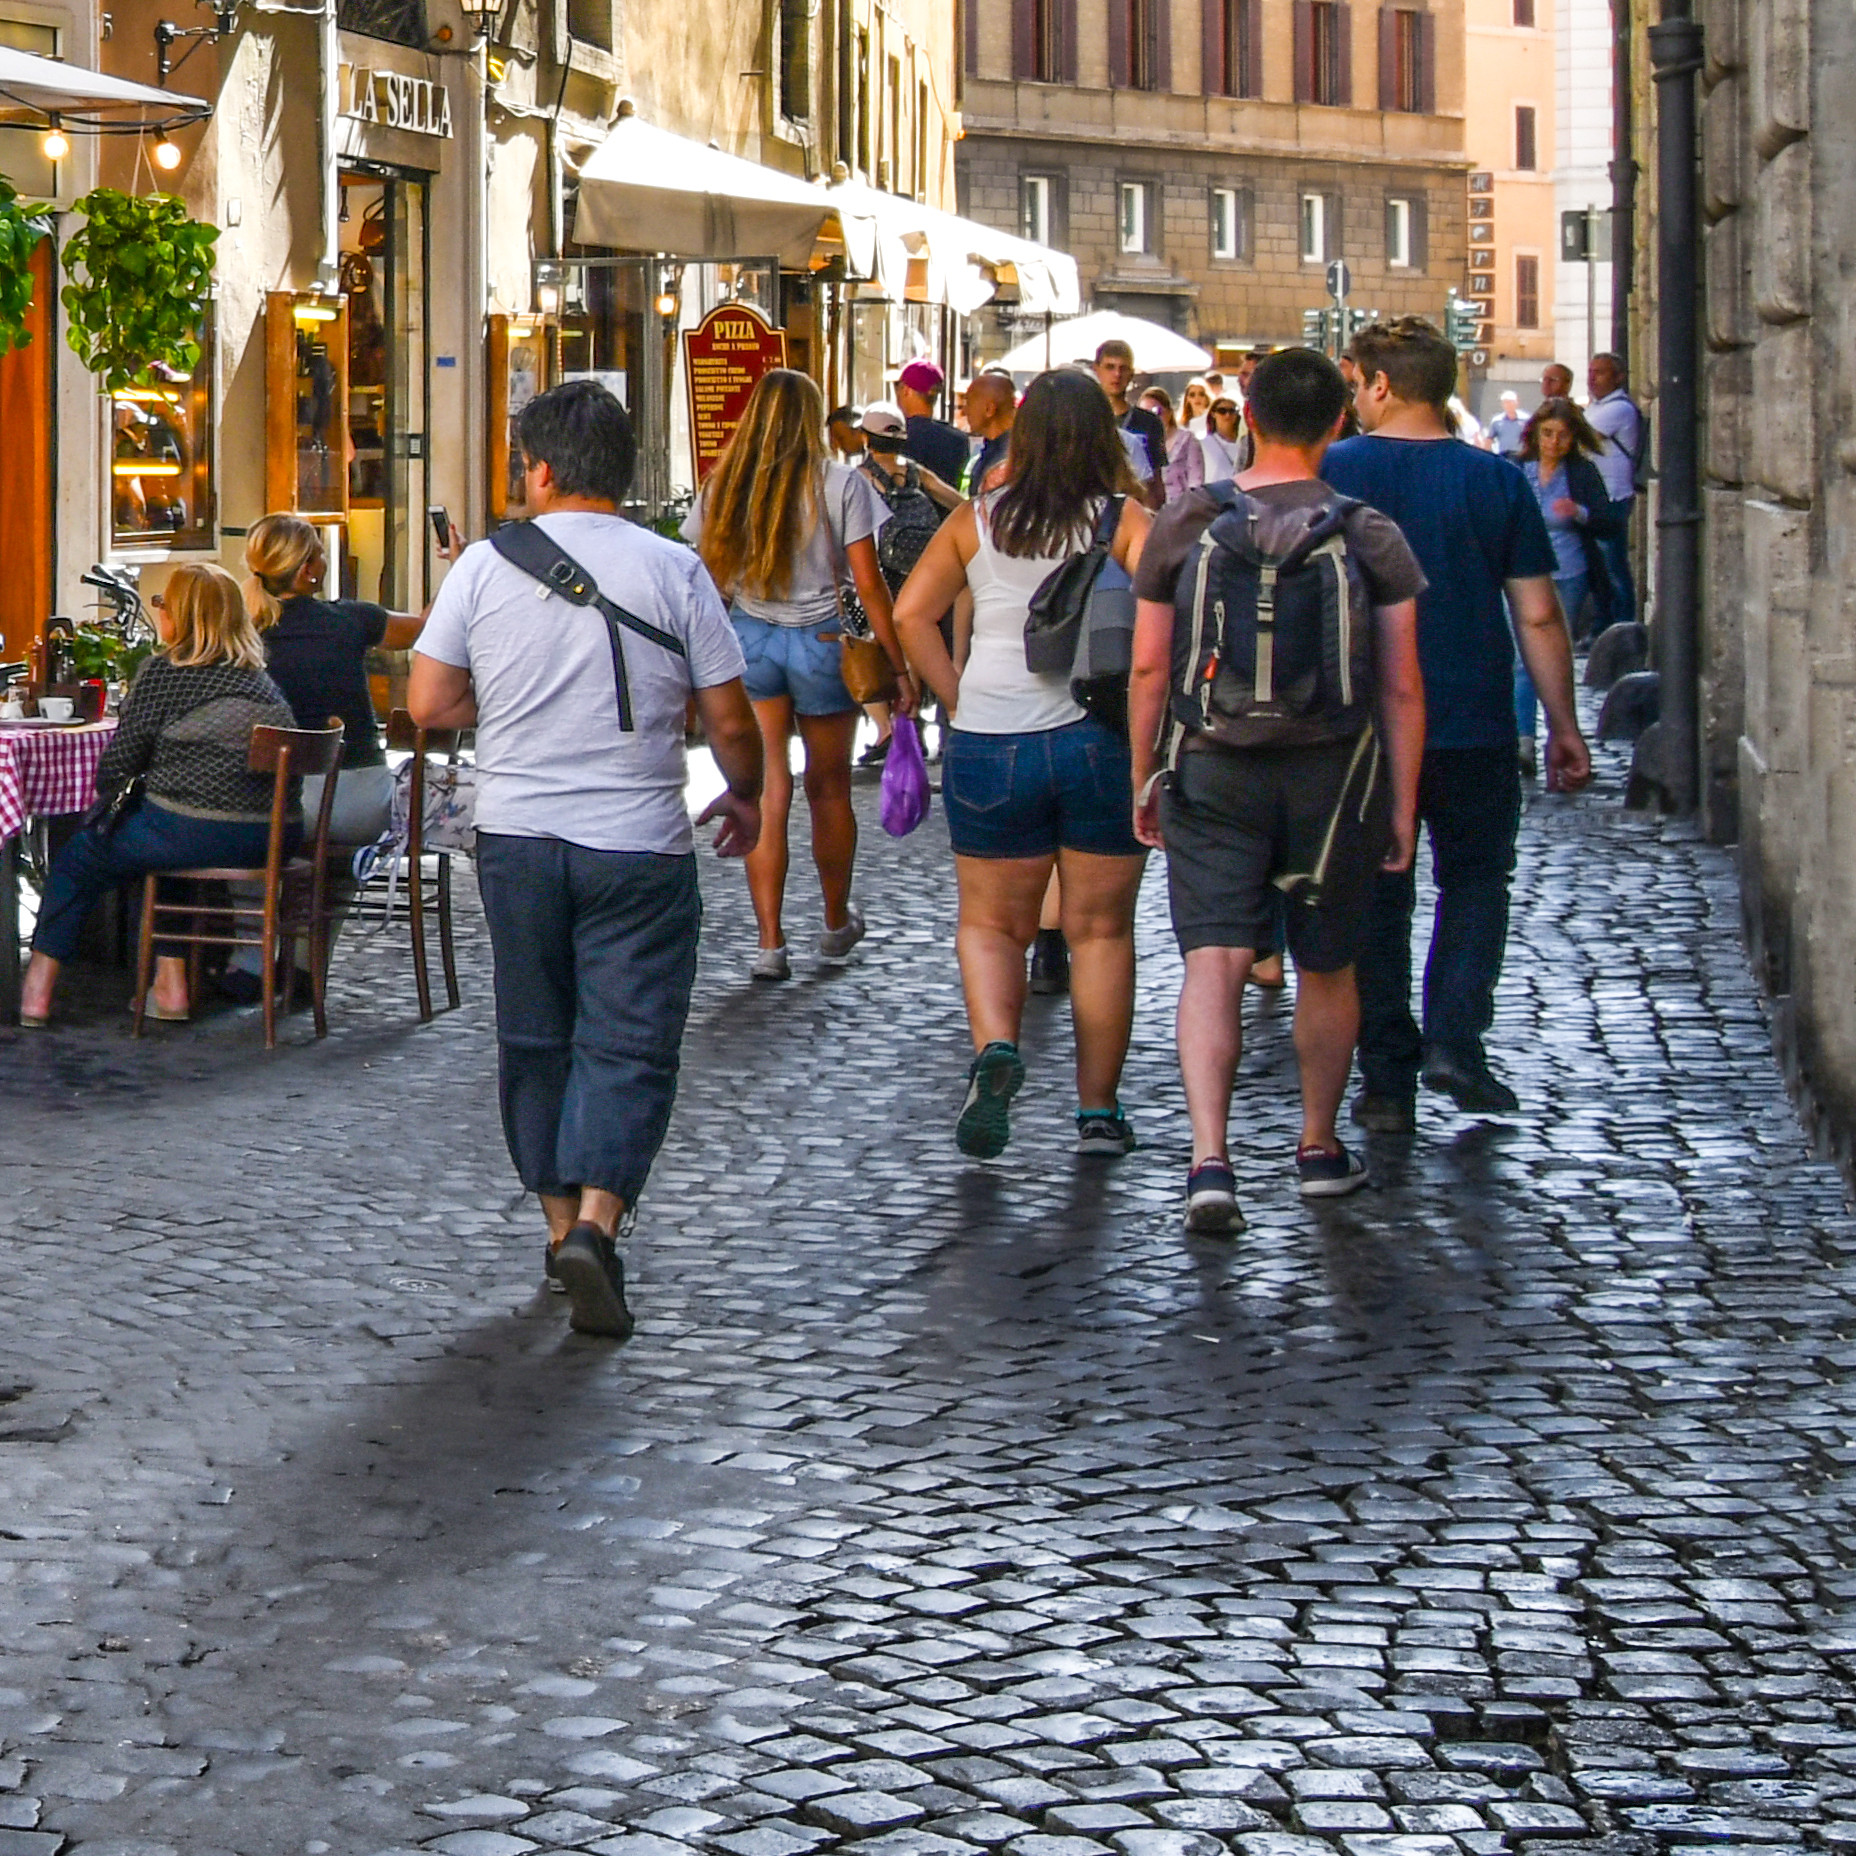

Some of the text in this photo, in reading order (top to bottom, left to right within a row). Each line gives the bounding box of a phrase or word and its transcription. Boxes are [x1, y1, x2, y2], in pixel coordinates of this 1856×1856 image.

[345, 63, 454, 139] LA SELLA
[713, 320, 755, 339] PIZZA
